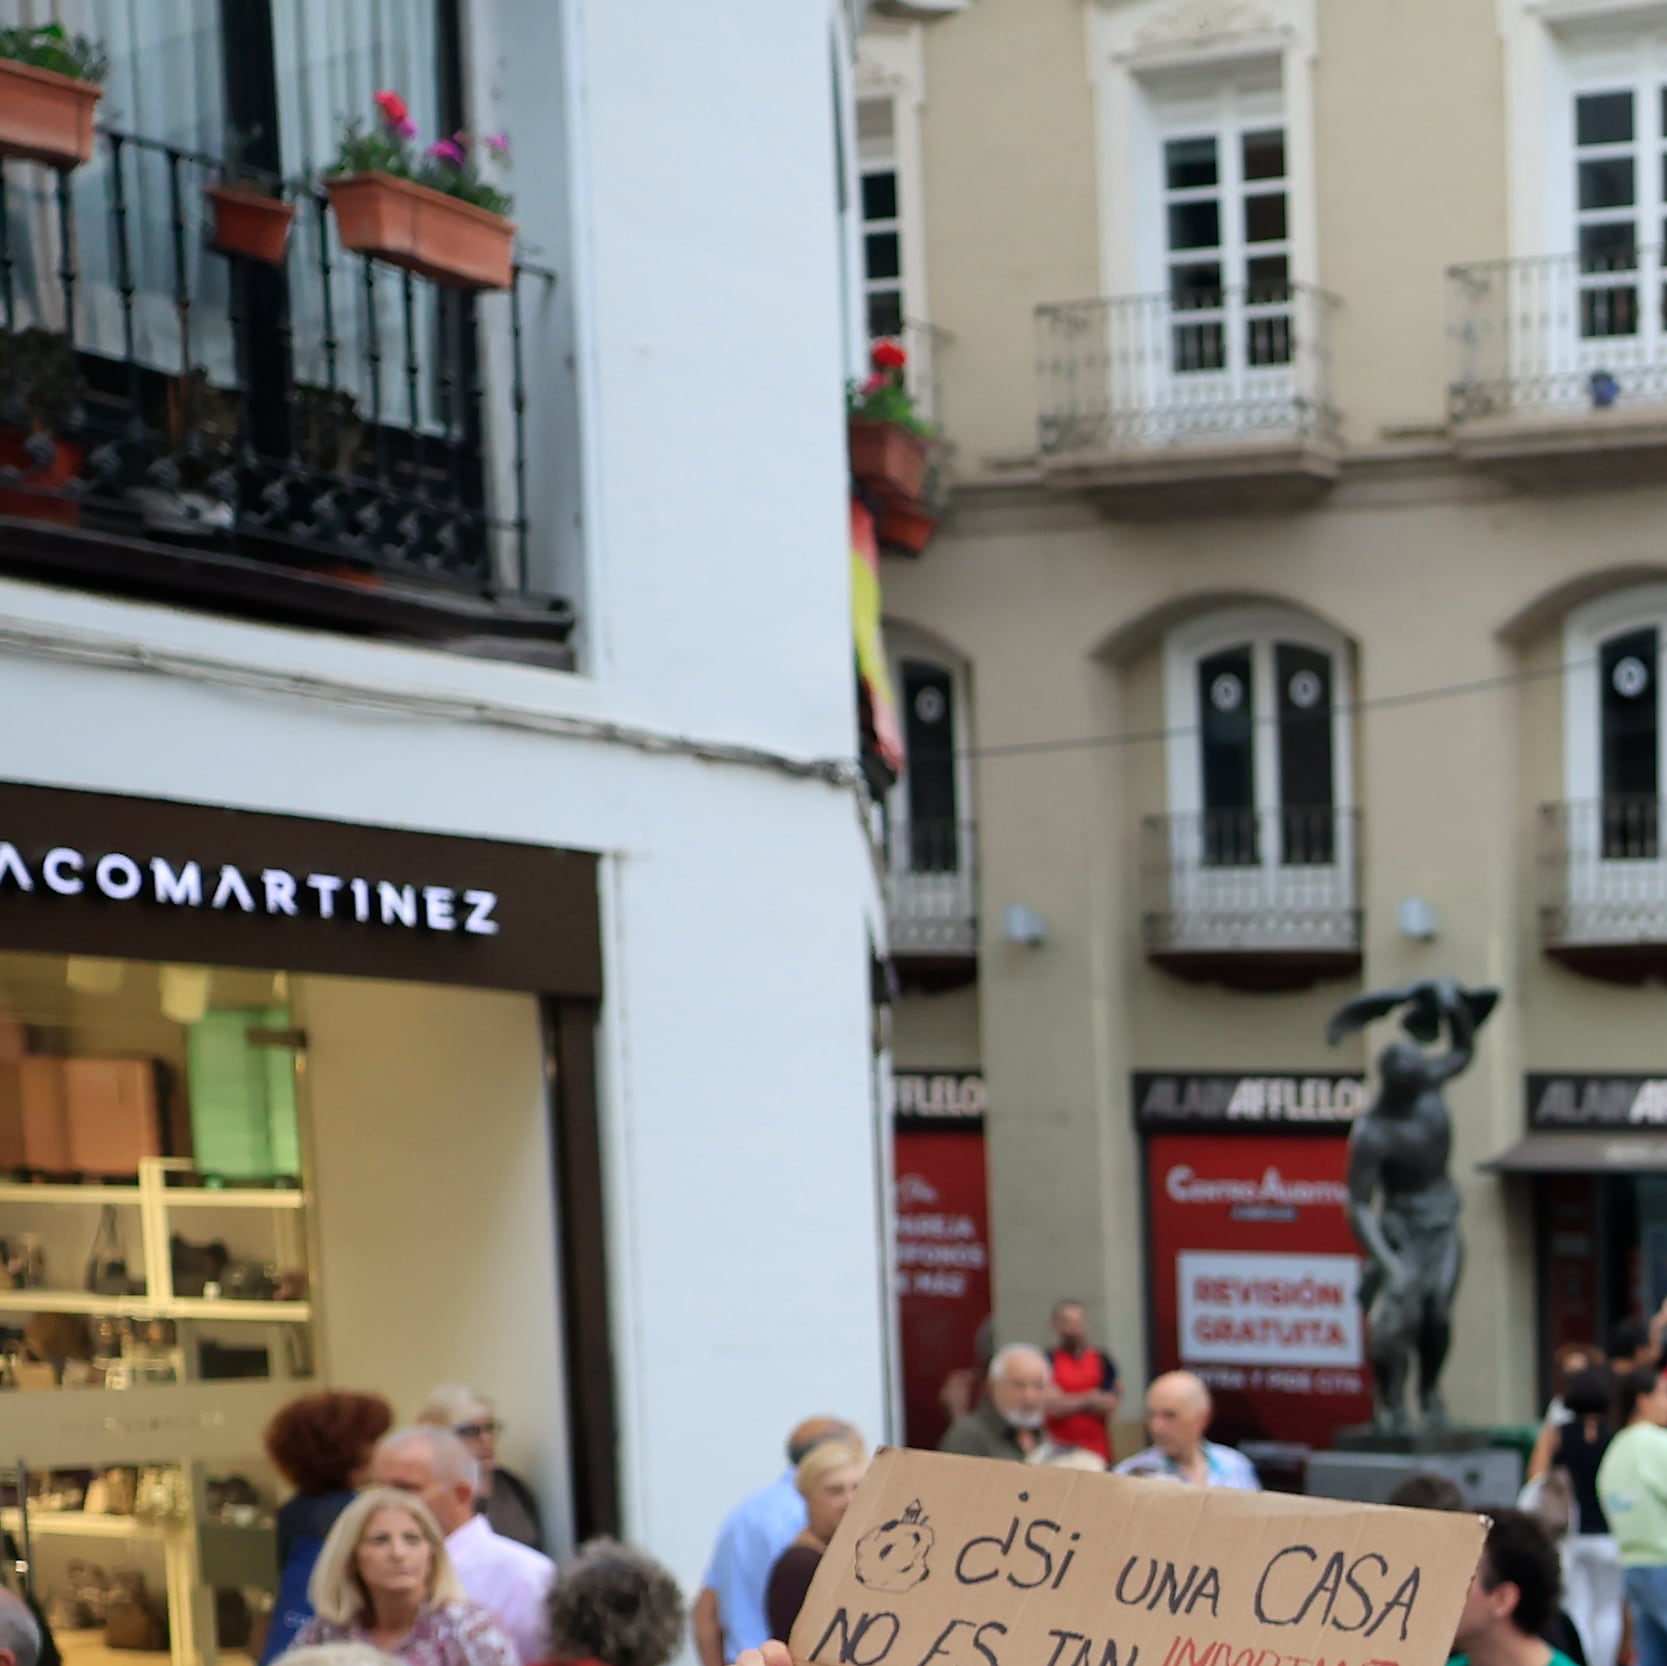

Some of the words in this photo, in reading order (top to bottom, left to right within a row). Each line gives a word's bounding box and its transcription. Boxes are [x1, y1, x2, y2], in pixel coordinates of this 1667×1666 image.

[1193, 1270, 1345, 1308] REVISIÓN
[1194, 1313, 1347, 1347] GRATUITA
[1114, 1555, 1221, 1616] UNA
[1254, 1544, 1421, 1641] CASA
